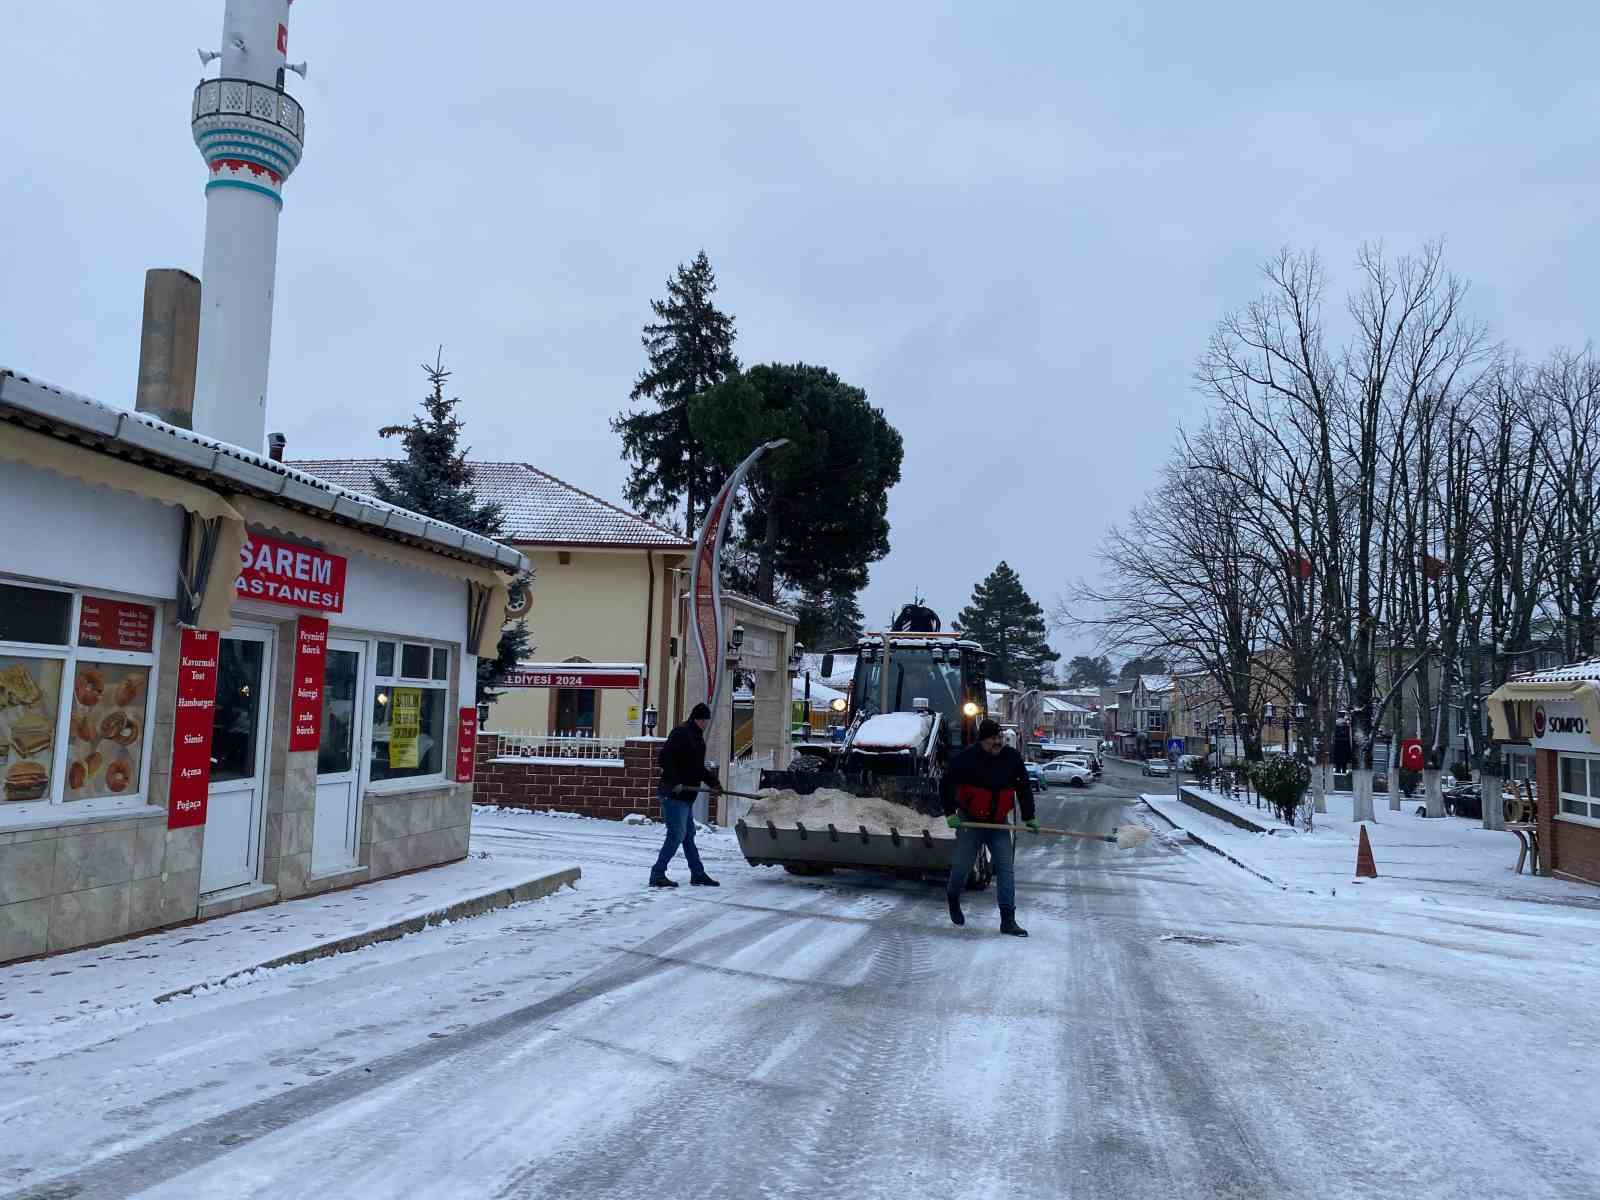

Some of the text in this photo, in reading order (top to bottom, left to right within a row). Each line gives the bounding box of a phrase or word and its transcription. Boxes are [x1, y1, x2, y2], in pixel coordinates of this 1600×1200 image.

[239, 540, 332, 585] SAREM
[233, 576, 340, 608] ASTANESİ
[191, 670, 205, 681] Tost
[556, 676, 582, 685] 2024
[178, 697, 214, 709] Hamburger
[1548, 716, 1584, 734] SOMPO
[183, 733, 204, 744] Simit
[181, 767, 202, 779] Açma
[176, 800, 202, 813] Poğaça
